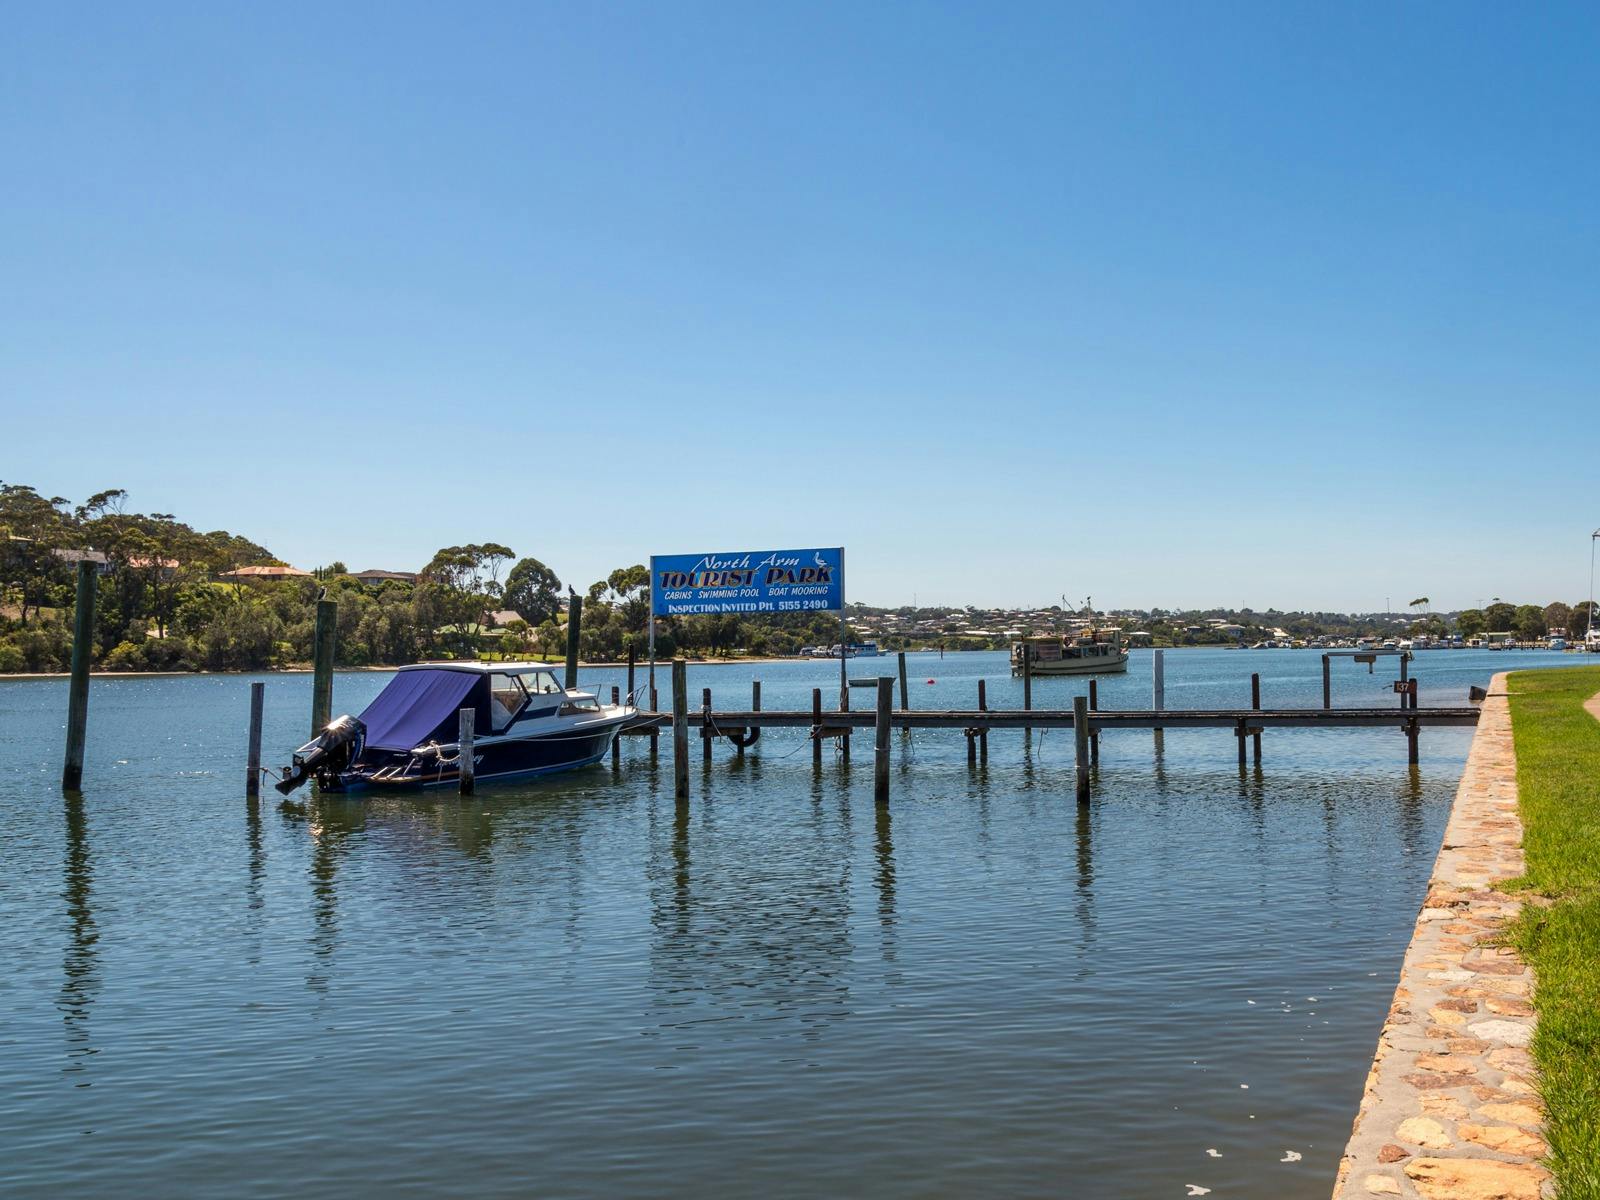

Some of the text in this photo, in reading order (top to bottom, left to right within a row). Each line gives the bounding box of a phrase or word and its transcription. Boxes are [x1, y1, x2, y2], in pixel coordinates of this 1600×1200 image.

[691, 553, 799, 573] North Arm
[660, 567, 834, 590] TOURIST PARK
[665, 586, 828, 600] CABINS SWIMMING POOL BOAT MOORING
[668, 604, 720, 613] INSPECTION
[722, 602, 756, 612] INVITED
[778, 601, 800, 610] 5155
[803, 600, 828, 609] 2490
